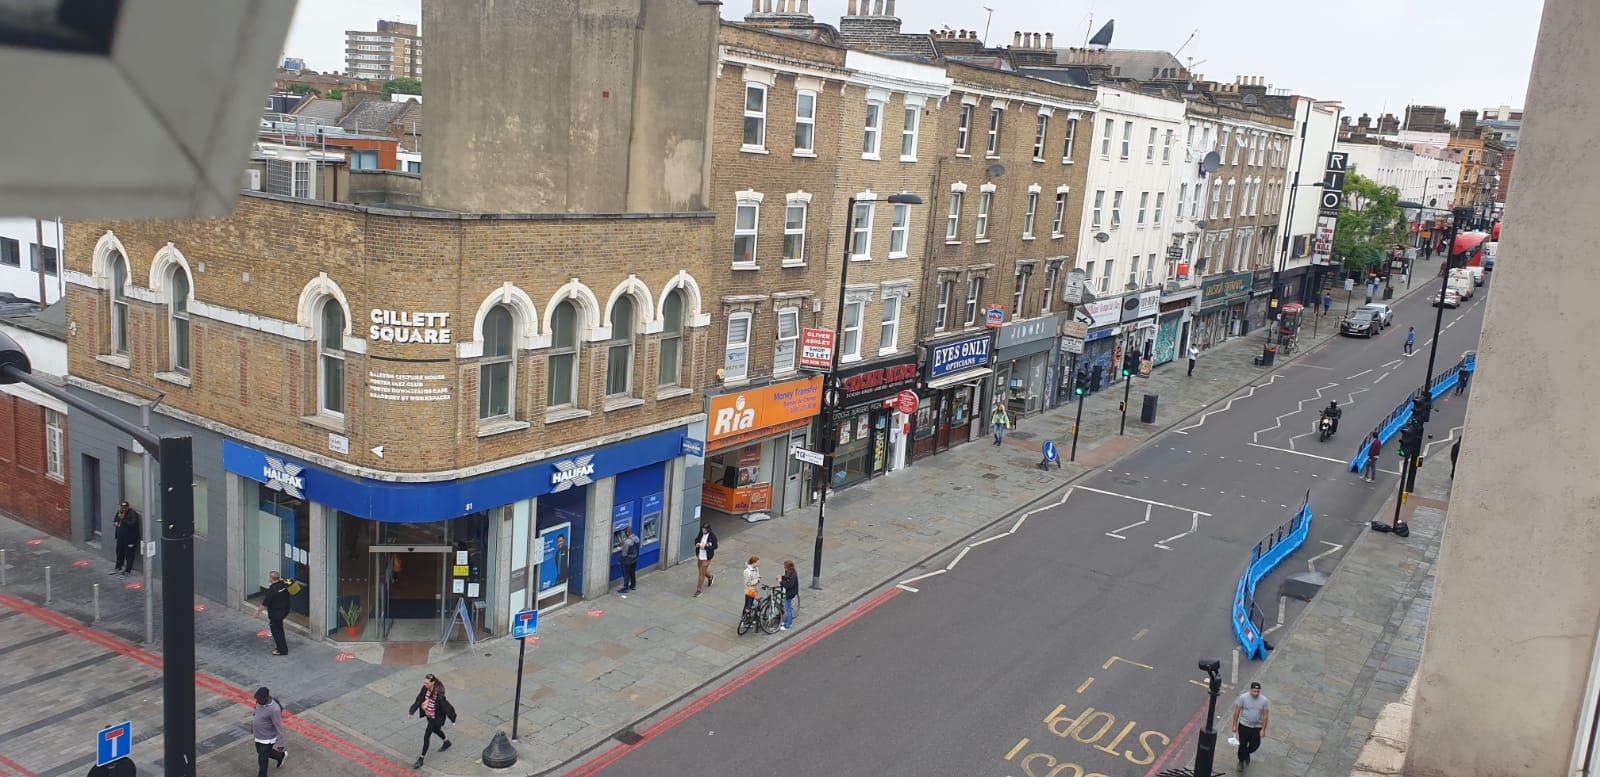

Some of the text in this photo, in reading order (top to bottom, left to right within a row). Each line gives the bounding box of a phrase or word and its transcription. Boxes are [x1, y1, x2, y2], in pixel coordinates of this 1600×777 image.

[1323, 154, 1344, 208] RIO
[370, 308, 450, 327] GILLETT
[370, 325, 452, 343] SQUARE
[804, 338, 831, 346] ASHLEY
[806, 331, 831, 340] OLIVER
[934, 339, 989, 367] EYES ONLY
[945, 358, 976, 371] OPTICIANS
[773, 392, 794, 402] Money
[795, 385, 818, 396] Transfer
[713, 395, 756, 436] Ria
[263, 466, 304, 490] HALIFAX
[552, 463, 595, 485] HALIFAX
[1043, 703, 1171, 765] STOP
